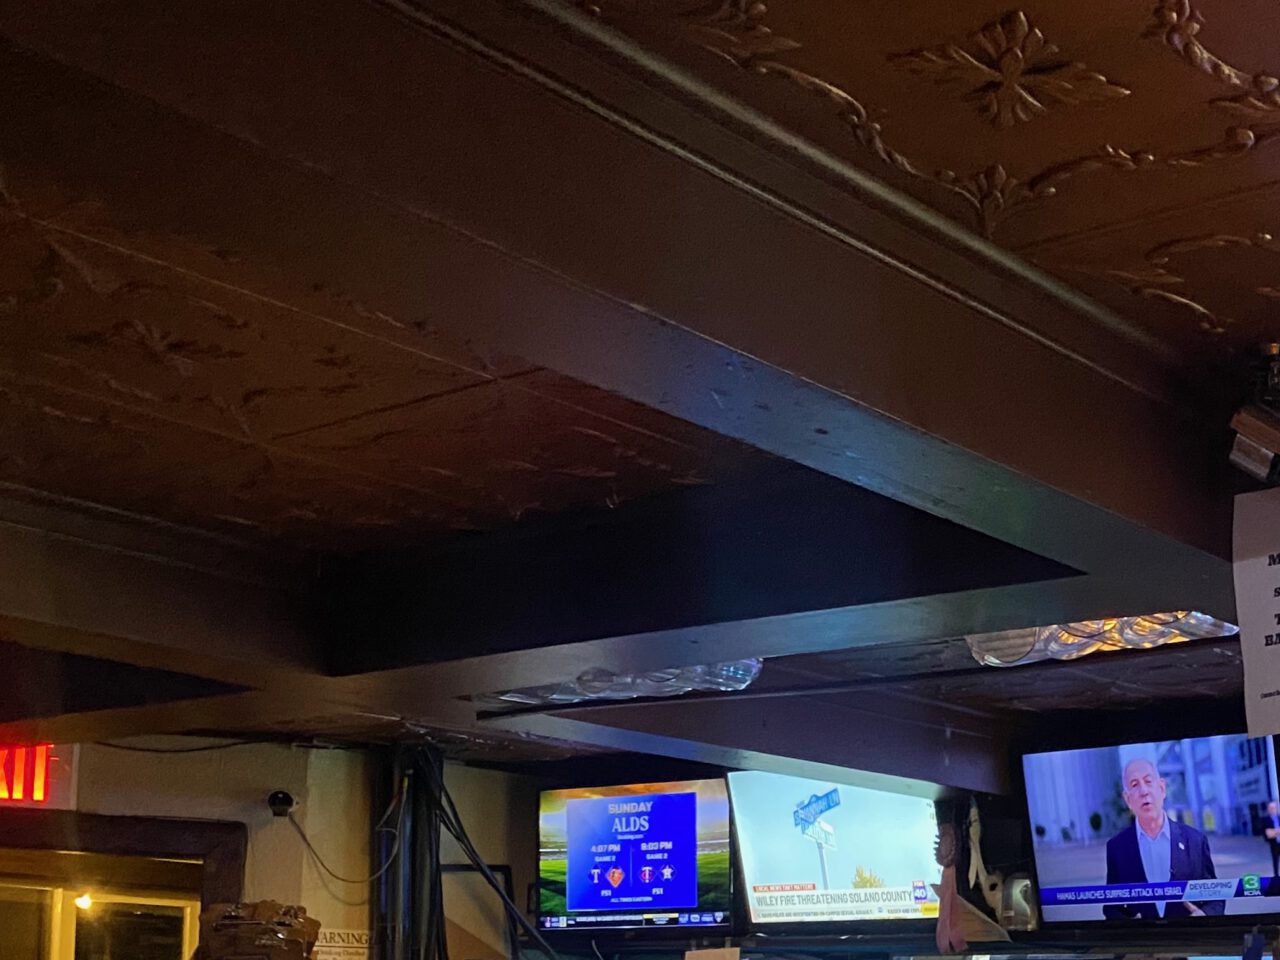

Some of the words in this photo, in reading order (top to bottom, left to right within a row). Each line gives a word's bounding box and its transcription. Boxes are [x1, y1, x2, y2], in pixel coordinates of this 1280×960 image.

[608, 801, 653, 814] SUNDAY
[612, 816, 649, 832] ALDS
[608, 844, 621, 852] PM
[659, 842, 673, 850] PM
[1189, 882, 1232, 891] DEVELOPING
[1244, 874, 1260, 889] 3
[756, 896, 778, 906] WILEY
[780, 895, 797, 906] FIRE
[797, 893, 848, 905] THREATENING
[848, 891, 880, 903] SOLANO
[881, 890, 912, 902] COUNTY
[1057, 891, 1075, 900] HAMAS
[1076, 890, 1105, 899] LAUNCHES
[1105, 889, 1130, 898] SURPRISE
[1131, 888, 1153, 897] ATTACK
[1154, 887, 1163, 895] ON
